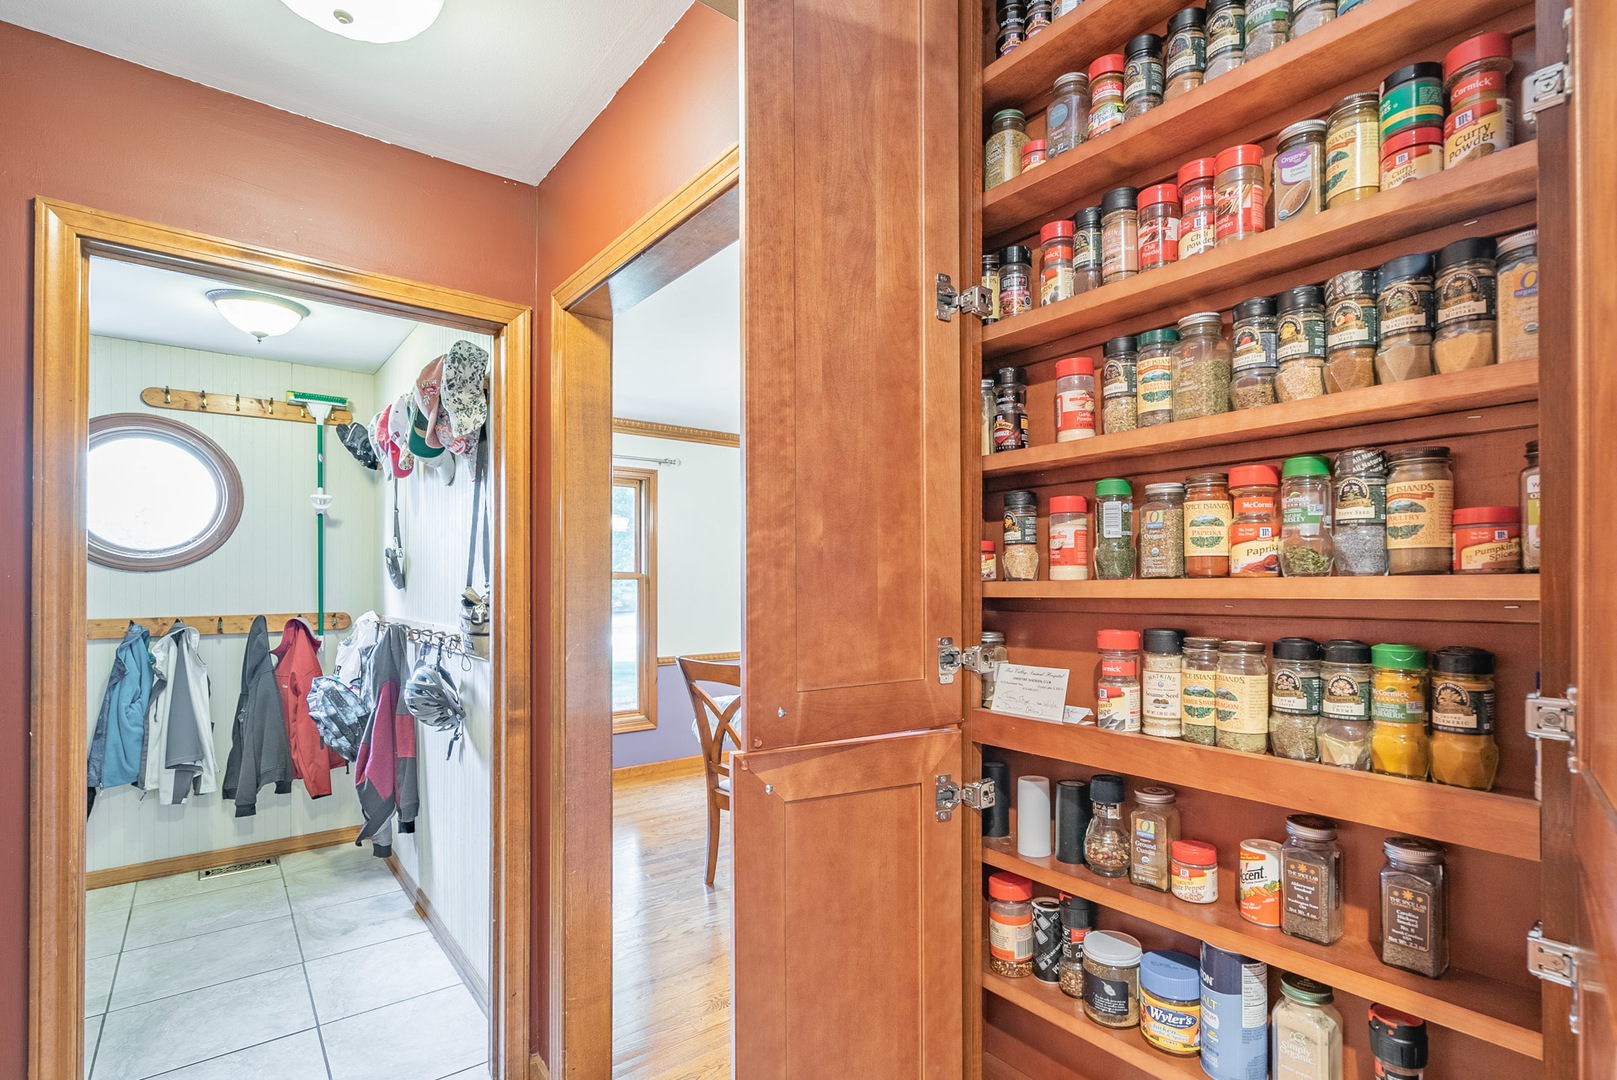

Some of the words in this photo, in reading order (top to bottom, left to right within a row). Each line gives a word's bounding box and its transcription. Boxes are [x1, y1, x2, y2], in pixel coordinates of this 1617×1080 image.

[1455, 122, 1491, 147] Curry
[1449, 131, 1496, 162] Powder
[1281, 151, 1307, 164] Organic
[1391, 163, 1414, 179] Curry
[1387, 169, 1417, 187] Powder
[1397, 482, 1434, 493] ISLANDS
[1246, 545, 1279, 557] Paprika
[1474, 542, 1514, 556] Pumpkin
[1488, 550, 1514, 561] Spice
[1148, 674, 1176, 683] WATKINS
[1146, 690, 1164, 699] Sesame
[1435, 716, 1471, 727] TURMERIC
[1135, 839, 1157, 851] Ground
[1136, 846, 1156, 857] Cumin
[1185, 885, 1207, 894] Pepper
[1396, 909, 1420, 920] Carolina
[1397, 914, 1419, 925] Hickory
[1396, 919, 1419, 929] Smoked
[1150, 1005, 1193, 1025] Wyler's
[1149, 1021, 1177, 1035] Chicken
[1282, 1040, 1312, 1057] Simply
[1280, 1045, 1314, 1065] Organic
